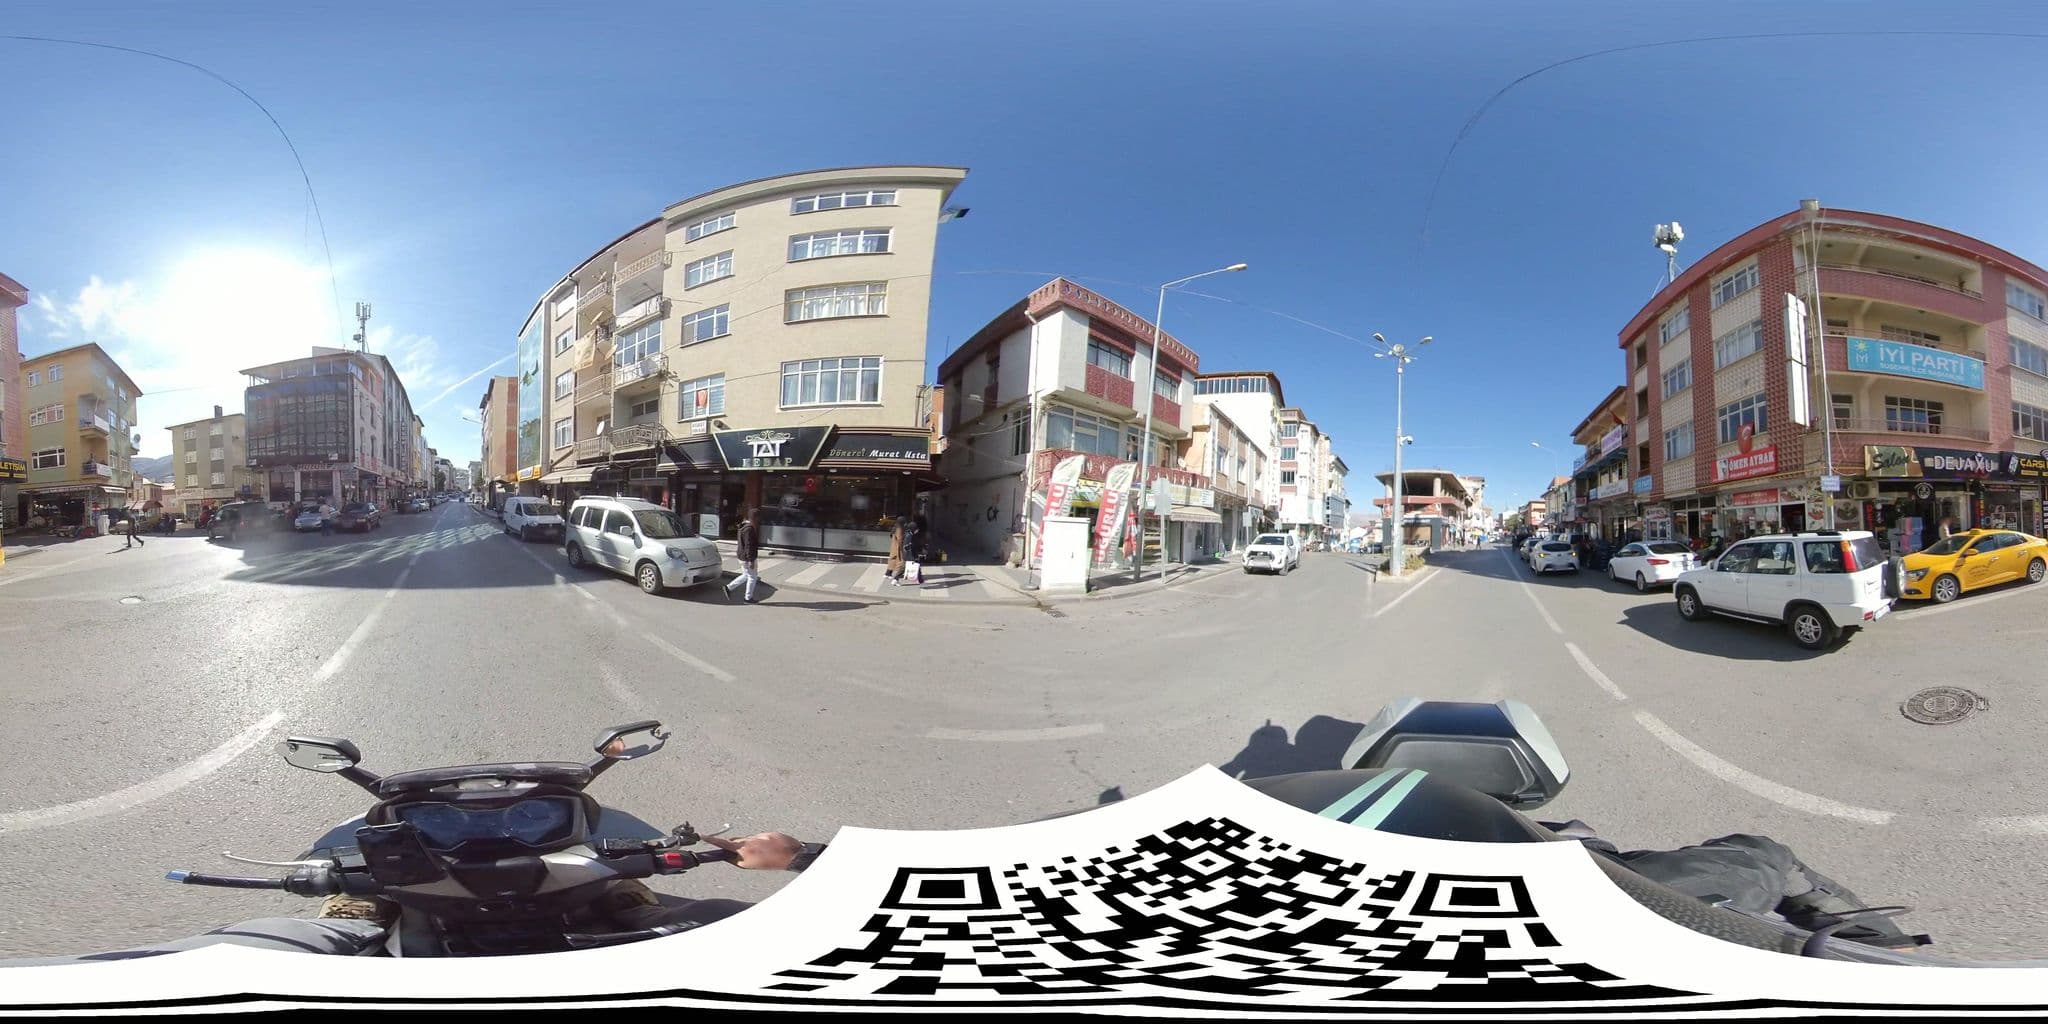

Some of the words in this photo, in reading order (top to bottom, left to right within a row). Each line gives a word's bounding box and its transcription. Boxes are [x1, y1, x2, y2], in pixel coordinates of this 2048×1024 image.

[1880, 344, 1904, 363] İYİ
[1911, 352, 1964, 374] PARTİ
[747, 439, 787, 457] TAT
[869, 449, 900, 458] Murat
[904, 450, 927, 460] Usta
[742, 457, 793, 467] KEBAP
